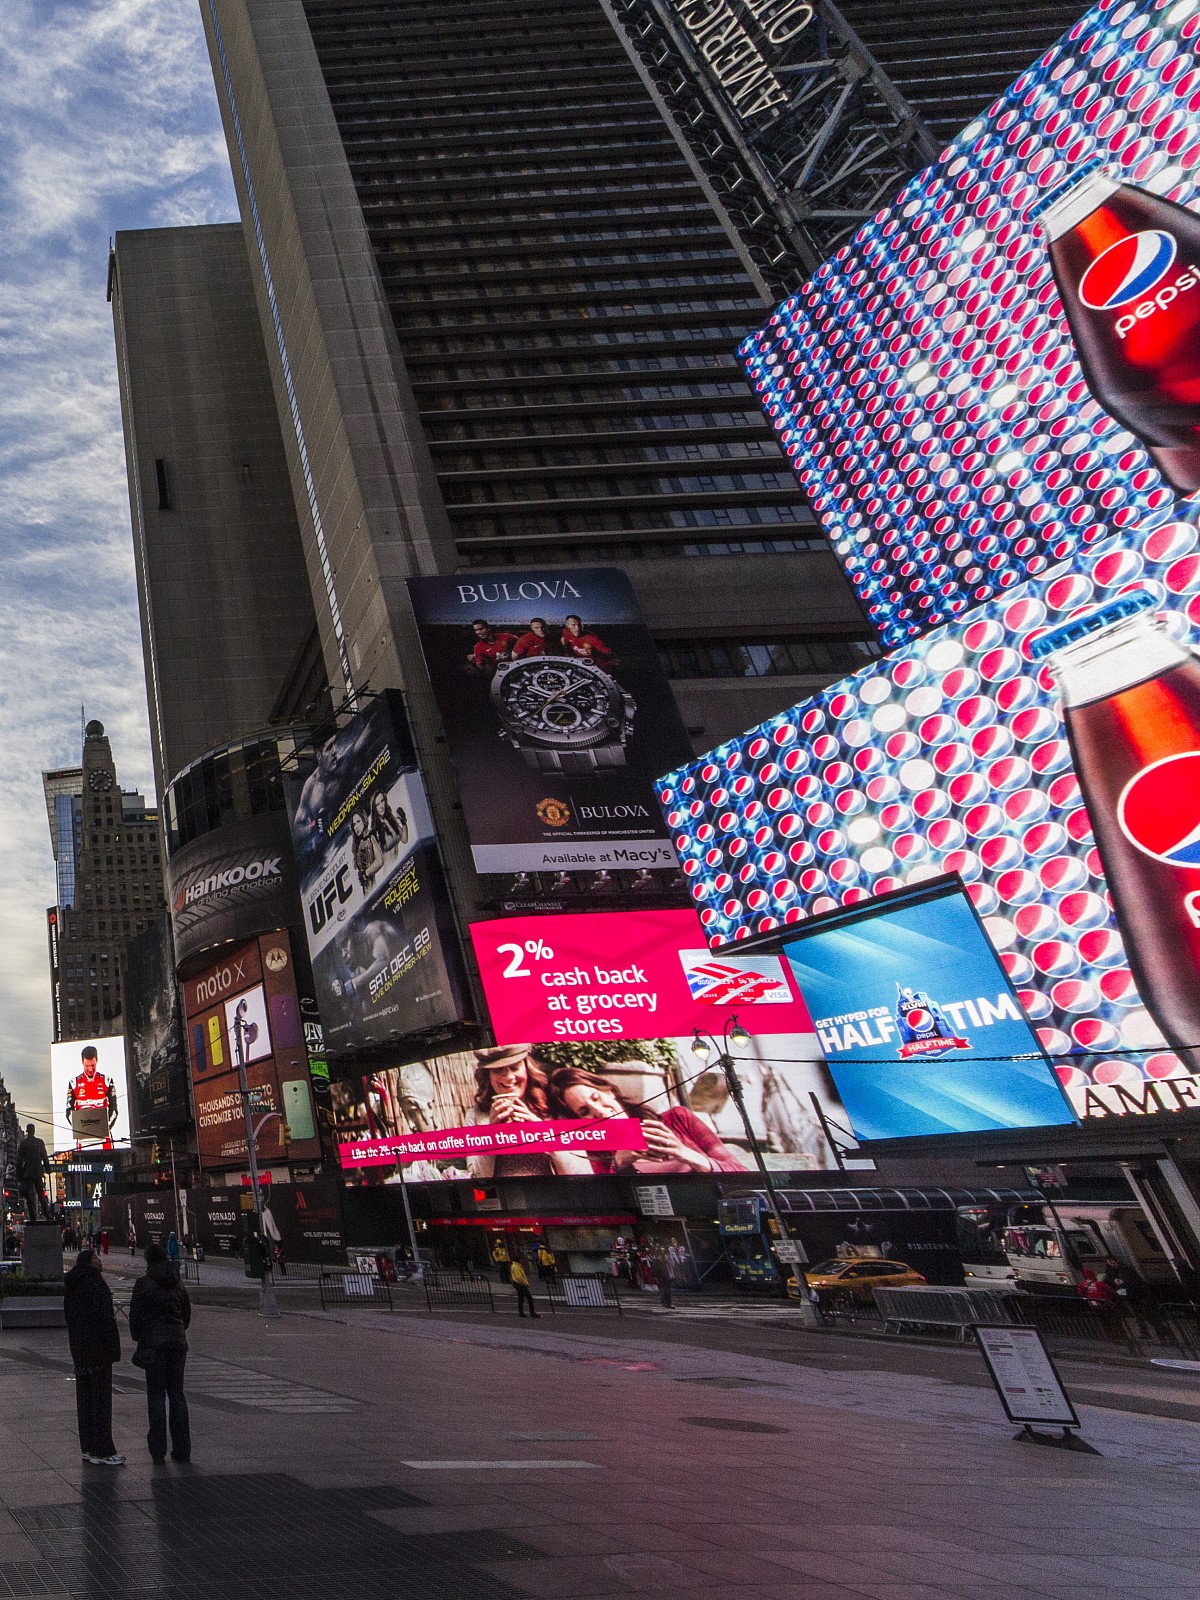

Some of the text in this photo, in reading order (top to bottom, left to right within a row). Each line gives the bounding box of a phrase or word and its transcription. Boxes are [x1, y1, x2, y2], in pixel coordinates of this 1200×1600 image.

[457, 580, 582, 603] BULOVA
[327, 791, 359, 837] WEIDMAN
[580, 805, 651, 818] BULOVA
[542, 848, 671, 864] Available at Macy's
[198, 876, 282, 907] driving emotion
[309, 863, 353, 936] UFC
[396, 879, 420, 908] TATE
[389, 944, 414, 974] DEC.
[413, 927, 431, 953] 28
[496, 939, 555, 979] 2%
[196, 967, 232, 1004] moto
[540, 964, 649, 987] cash back
[371, 985, 385, 1004] LIVE
[547, 992, 658, 1014] at grocery
[767, 991, 790, 999] VISA
[553, 1018, 624, 1035] stores
[815, 1006, 890, 1032] GET HYPED FOR
[817, 1015, 897, 1055] HALF
[907, 1038, 957, 1053] HALFTIME
[916, 1030, 938, 1041] pepsi
[199, 1097, 235, 1115] THOUSANDS
[199, 1109, 232, 1128] CUSTOMIZE
[351, 1148, 367, 1160] Like
[379, 1144, 392, 1157] 2%
[408, 1141, 427, 1154] back
[427, 1141, 437, 1151] on
[438, 1136, 465, 1150] coffee
[465, 1134, 492, 1149] from
[495, 1131, 518, 1146] the
[520, 1128, 556, 1144] local
[560, 1130, 607, 1145] grocer
[144, 1212, 165, 1221] VORNADO
[208, 1212, 237, 1221] VORNADO
